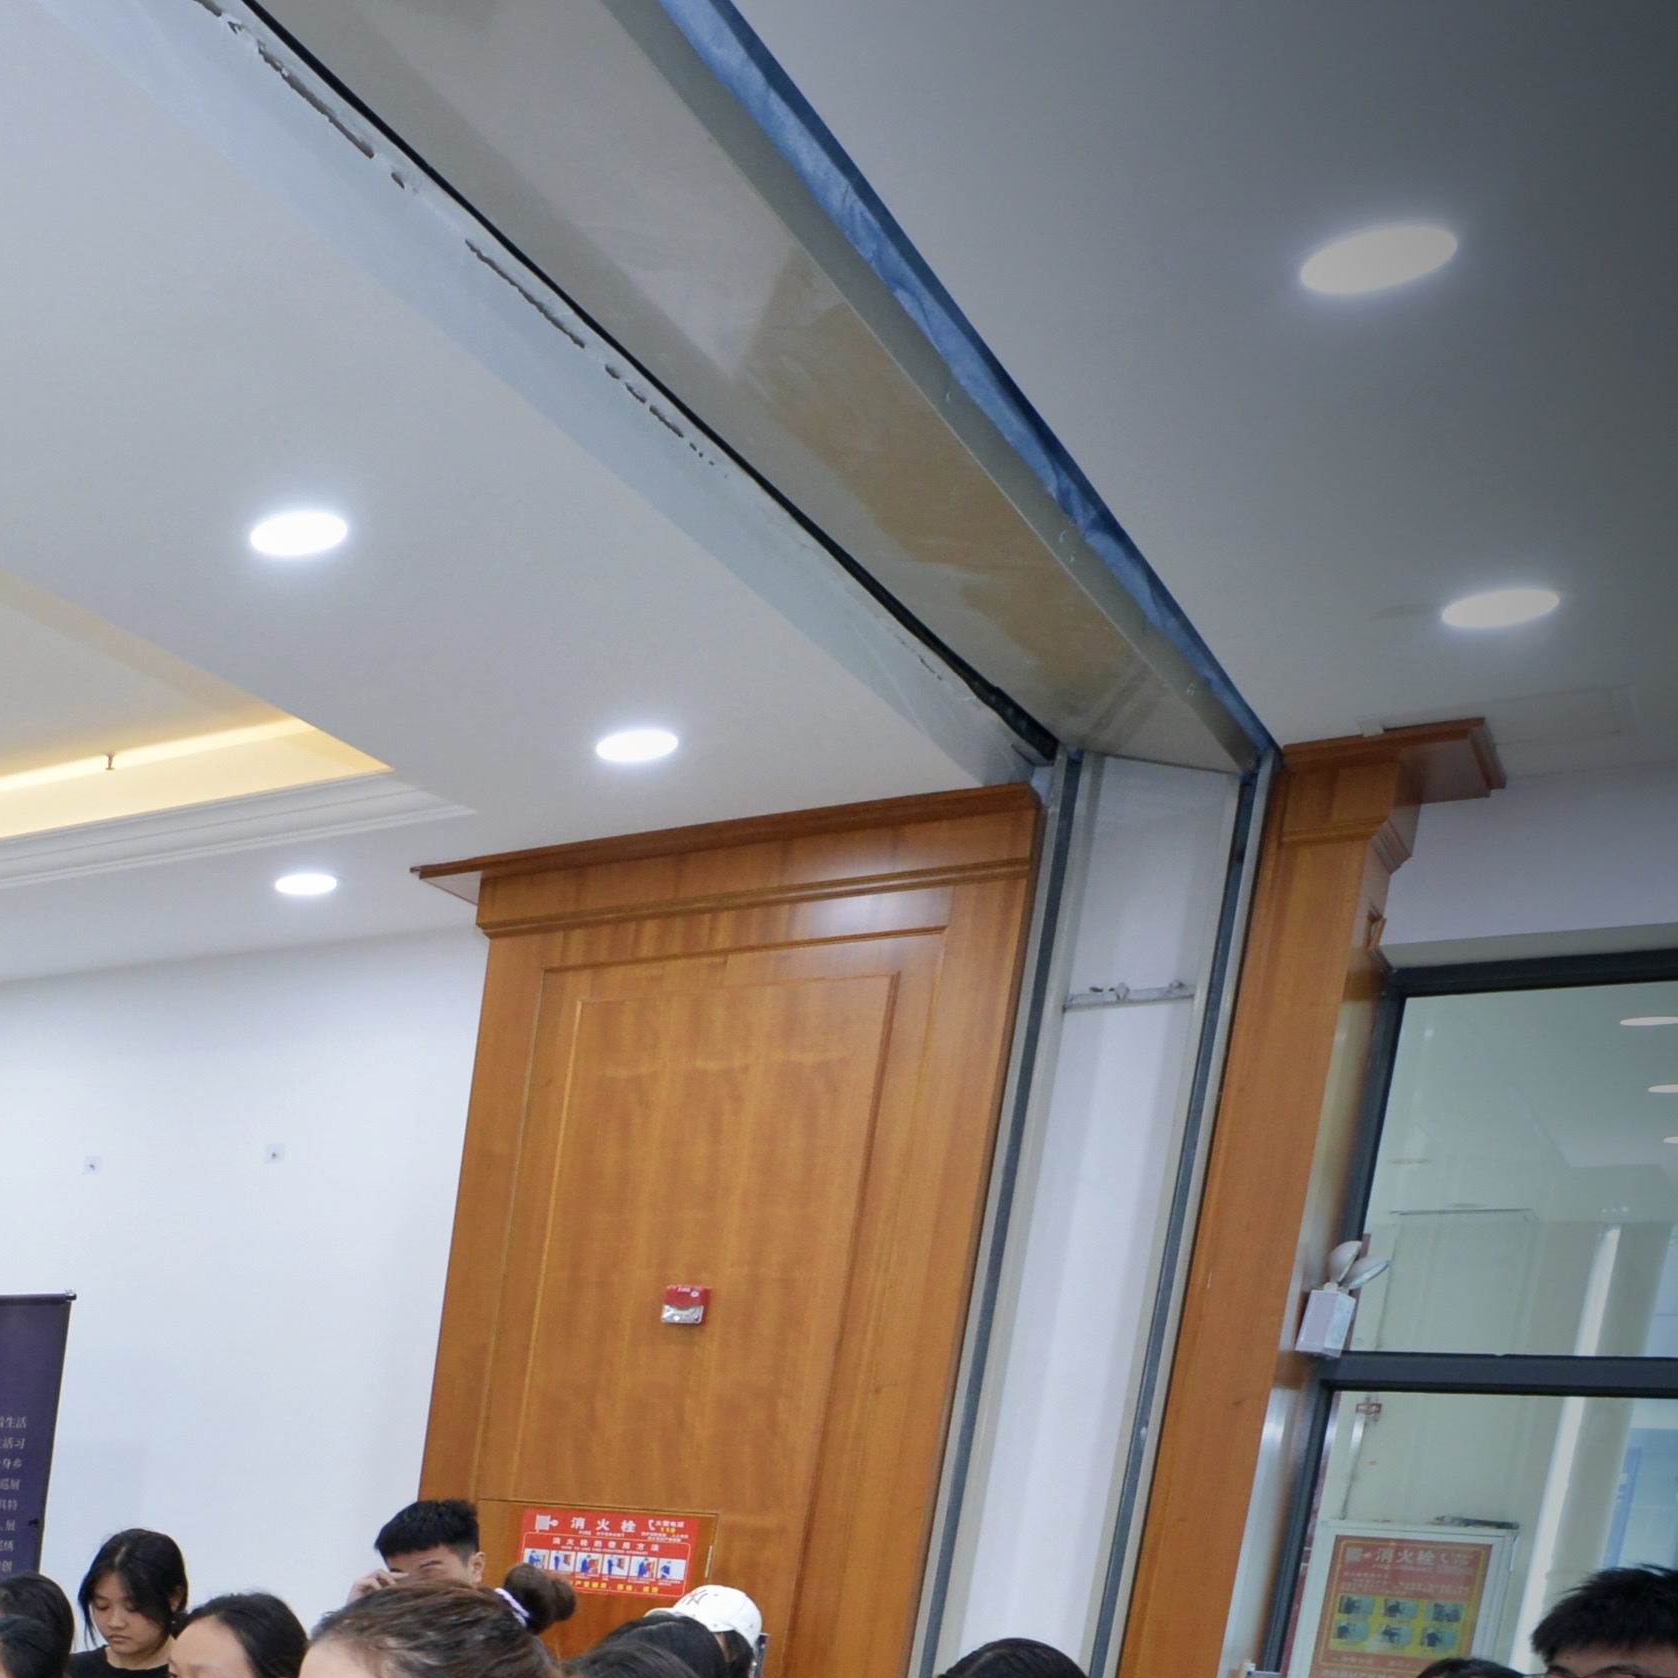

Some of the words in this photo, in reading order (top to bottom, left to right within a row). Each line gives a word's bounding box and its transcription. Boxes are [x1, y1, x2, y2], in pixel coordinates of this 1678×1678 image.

[570, 1516, 636, 1533] 消火栓
[1374, 1547, 1436, 1566] 消火栓
